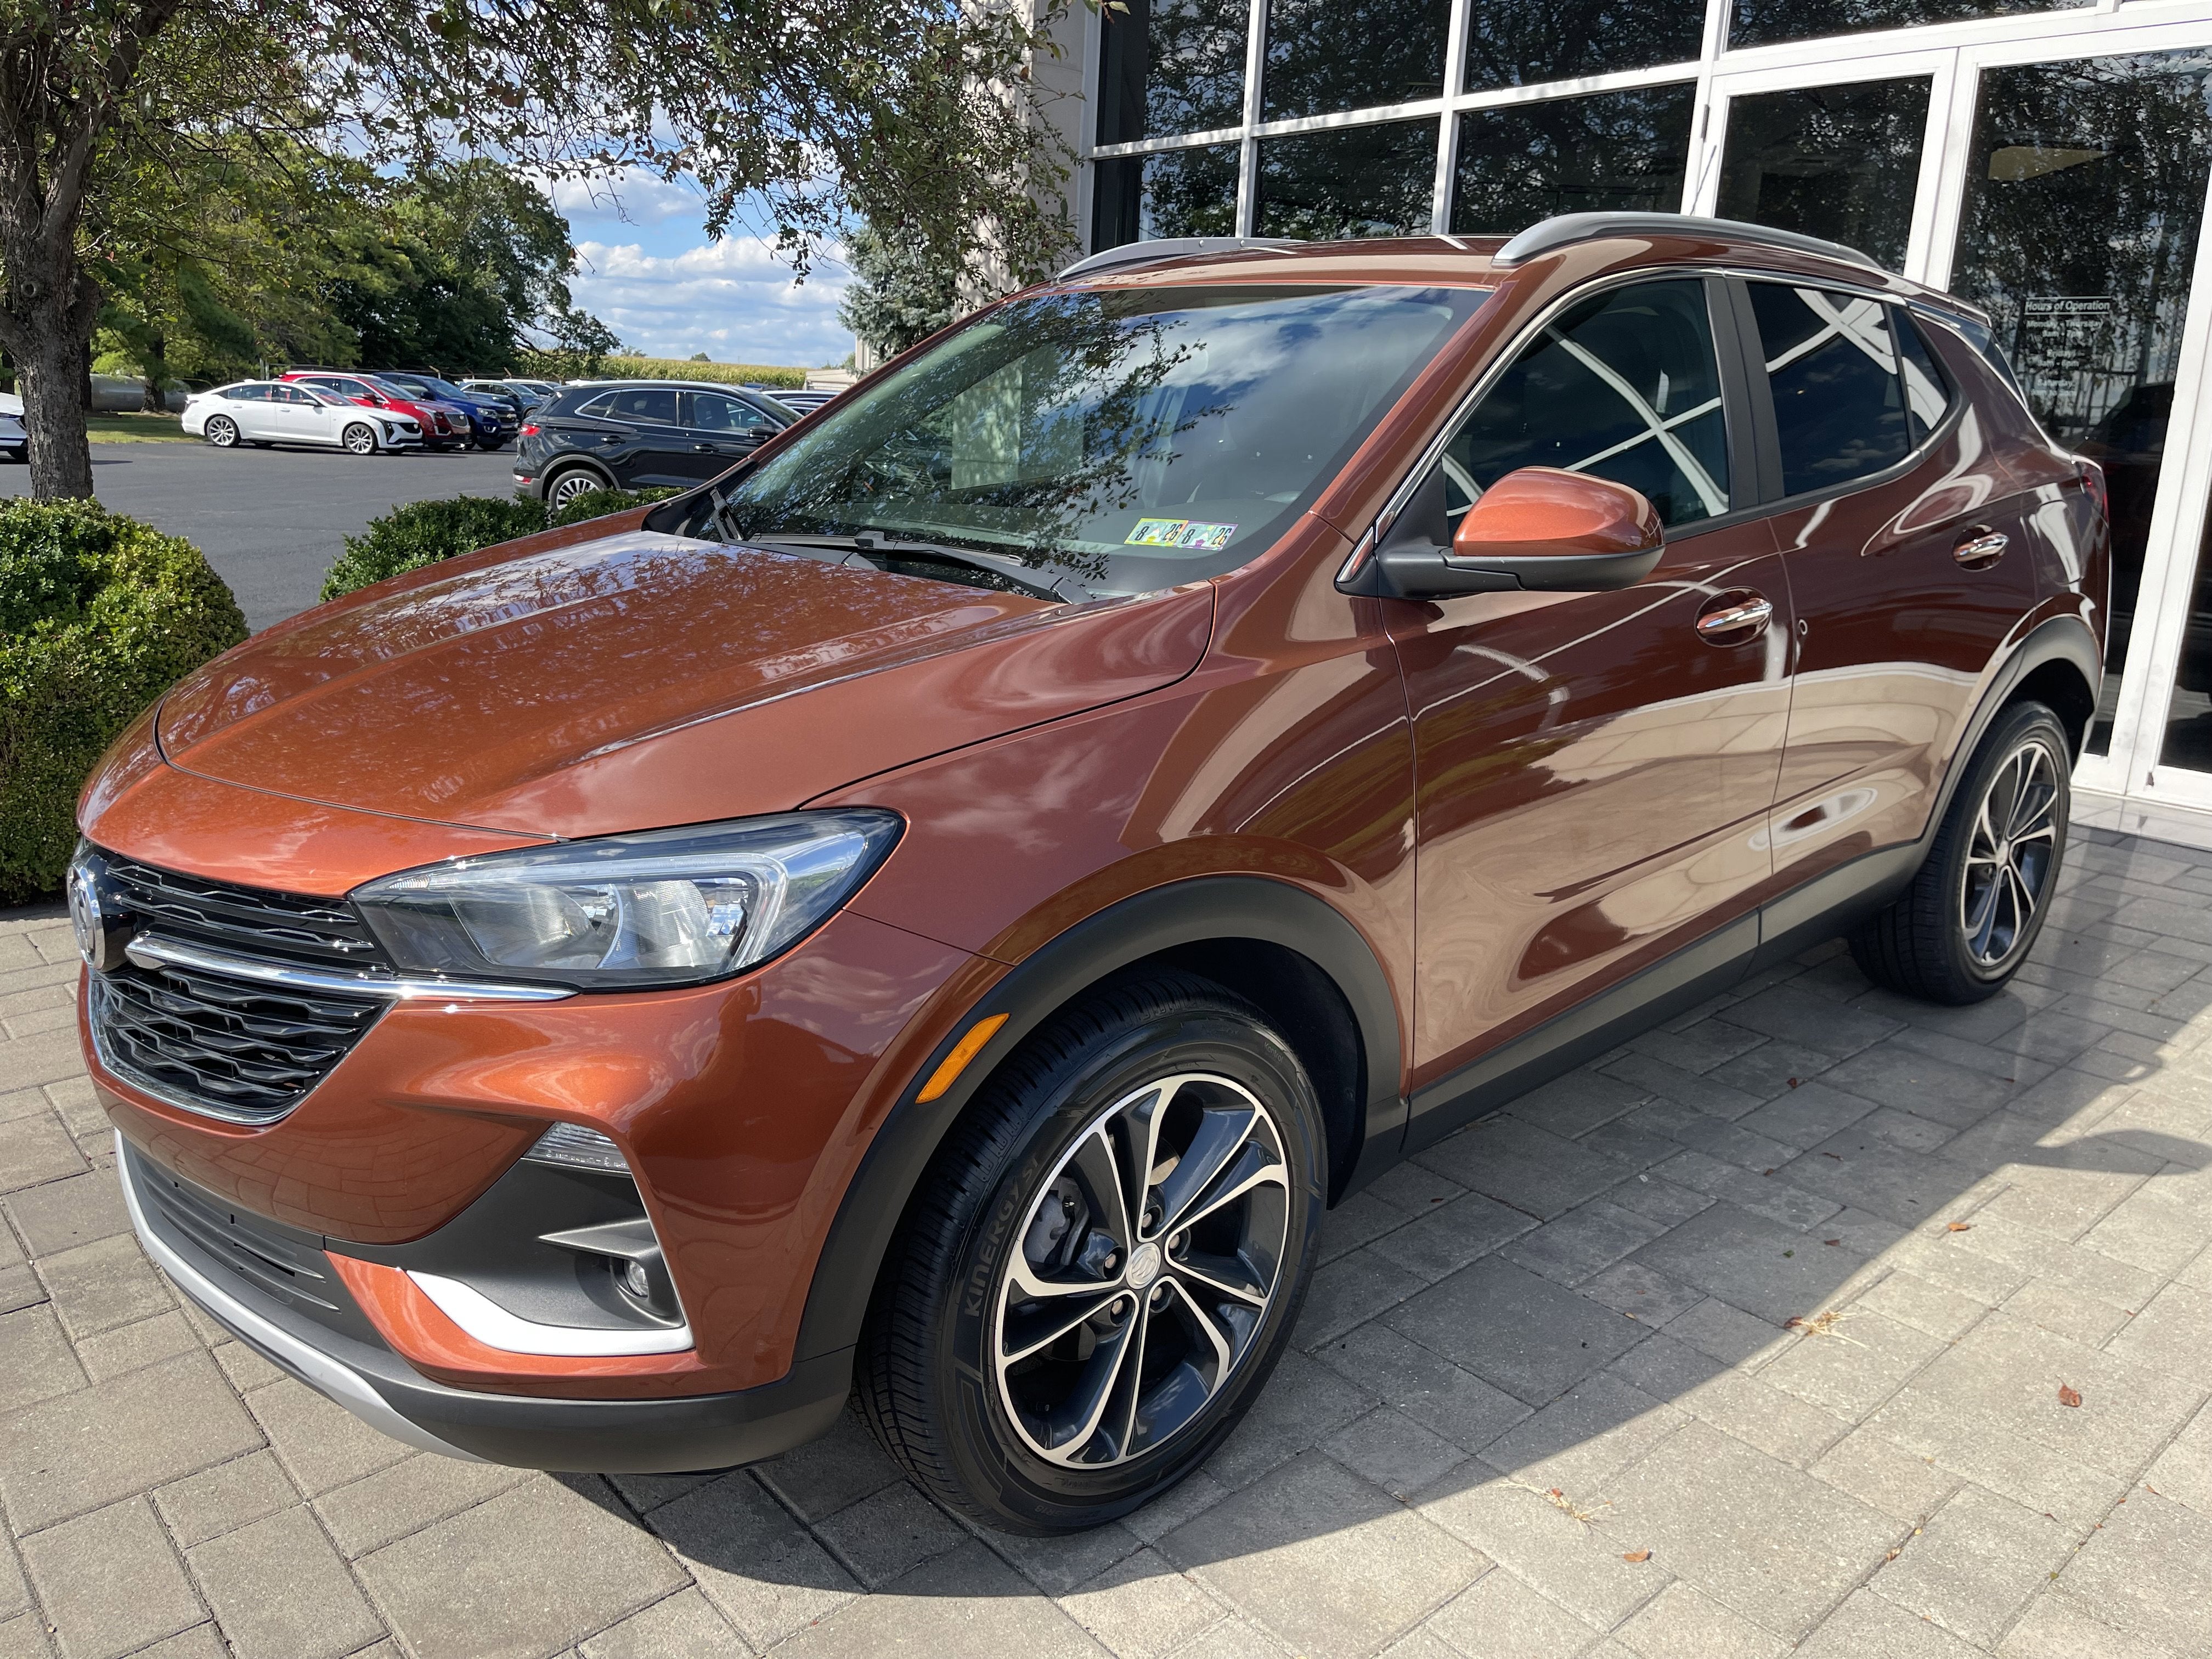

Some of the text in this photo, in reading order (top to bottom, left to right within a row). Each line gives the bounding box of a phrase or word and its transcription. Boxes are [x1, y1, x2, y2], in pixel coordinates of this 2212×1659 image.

[2025, 300, 2110, 312] Hours of Operation
[1134, 523, 1183, 541] 8 26
[1181, 527, 1233, 545] 8 26
